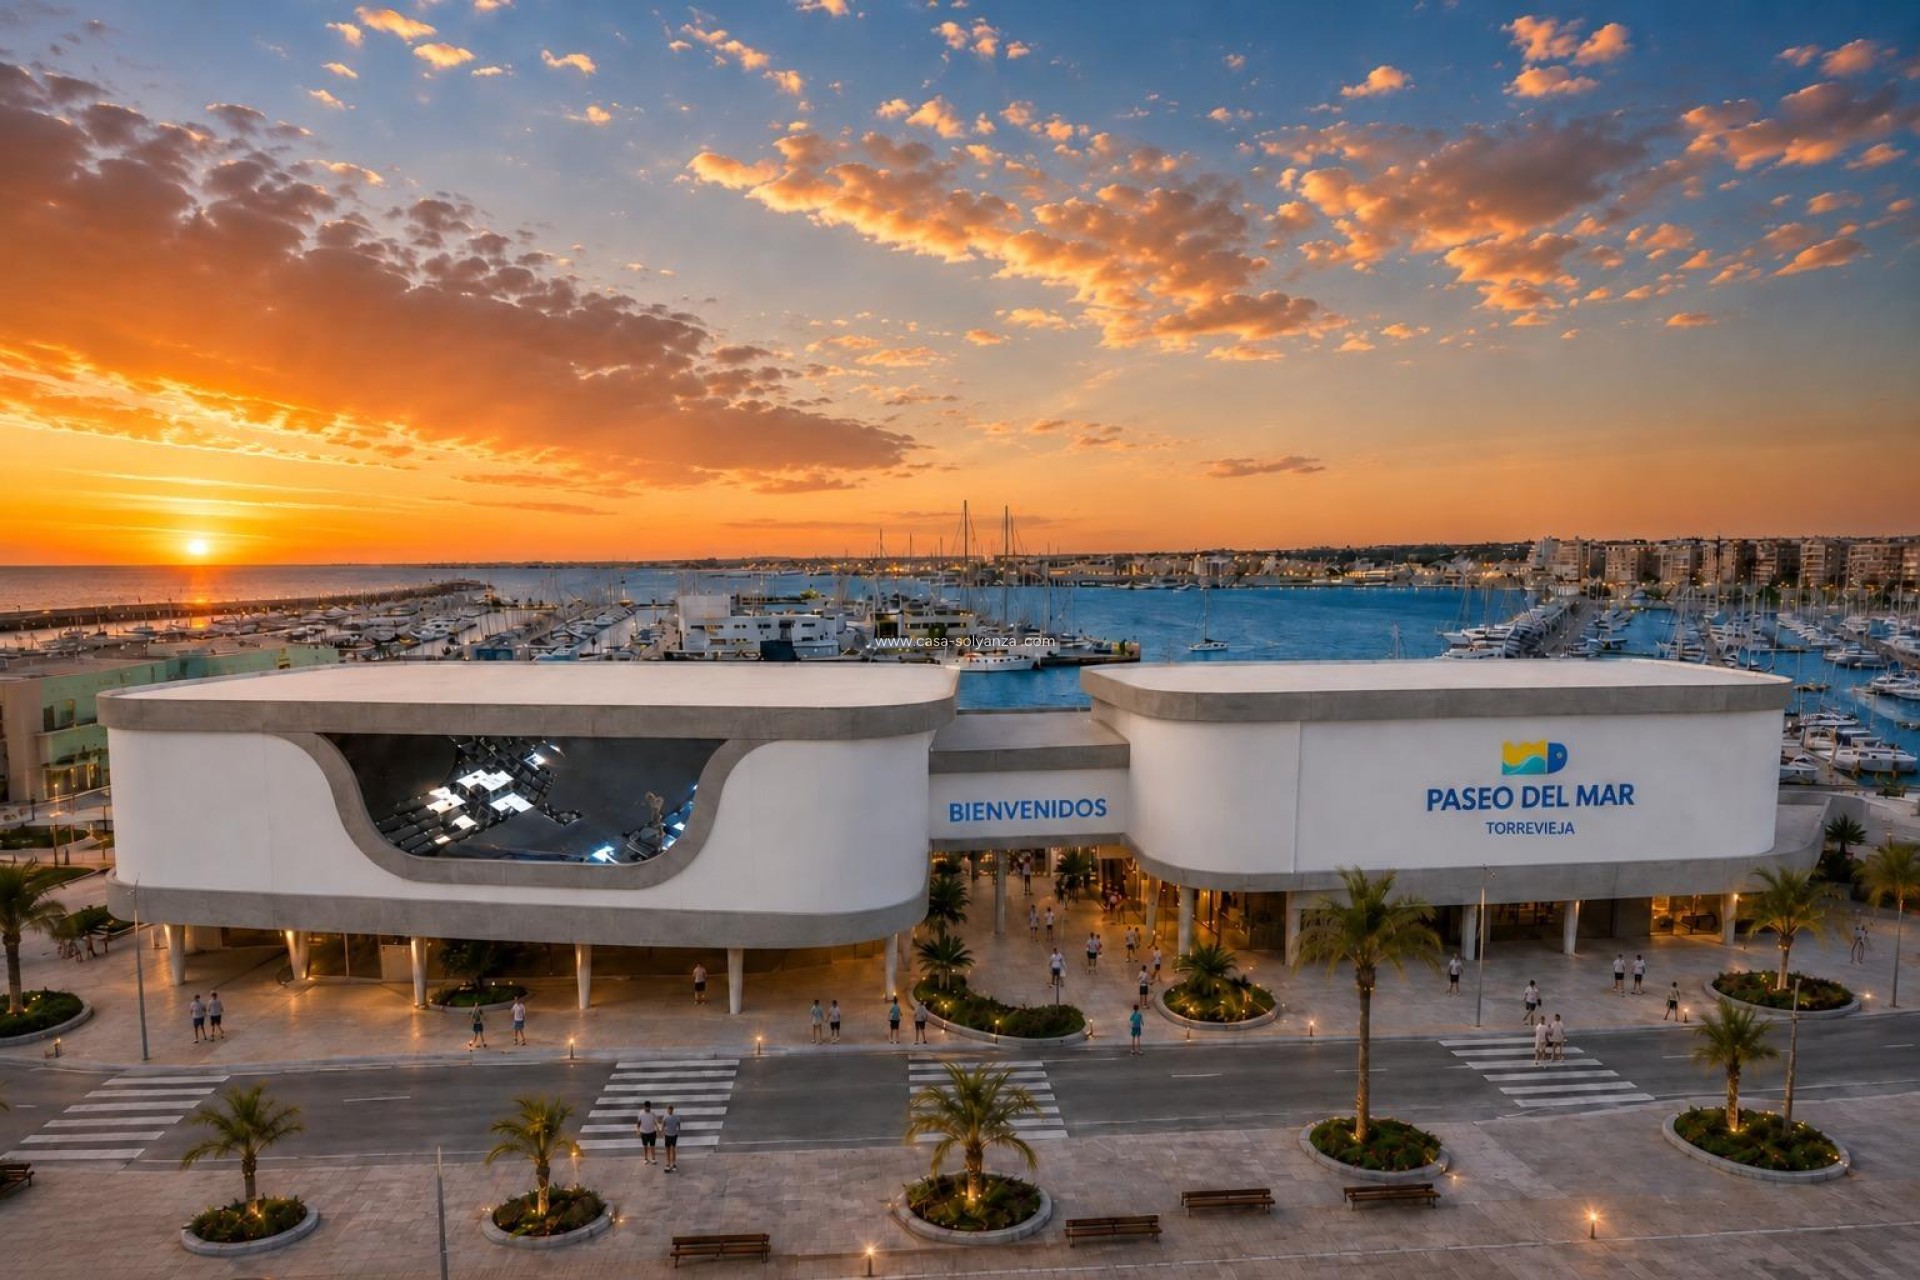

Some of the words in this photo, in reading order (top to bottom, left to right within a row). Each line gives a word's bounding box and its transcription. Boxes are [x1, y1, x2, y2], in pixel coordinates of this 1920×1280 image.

[1427, 786, 1514, 811] PASEO
[1521, 785, 1569, 809] DEL
[1576, 783, 1635, 807] MAR
[949, 798, 1107, 823] BIENVENIDOS
[1486, 821, 1575, 835] TORREVIEJA
